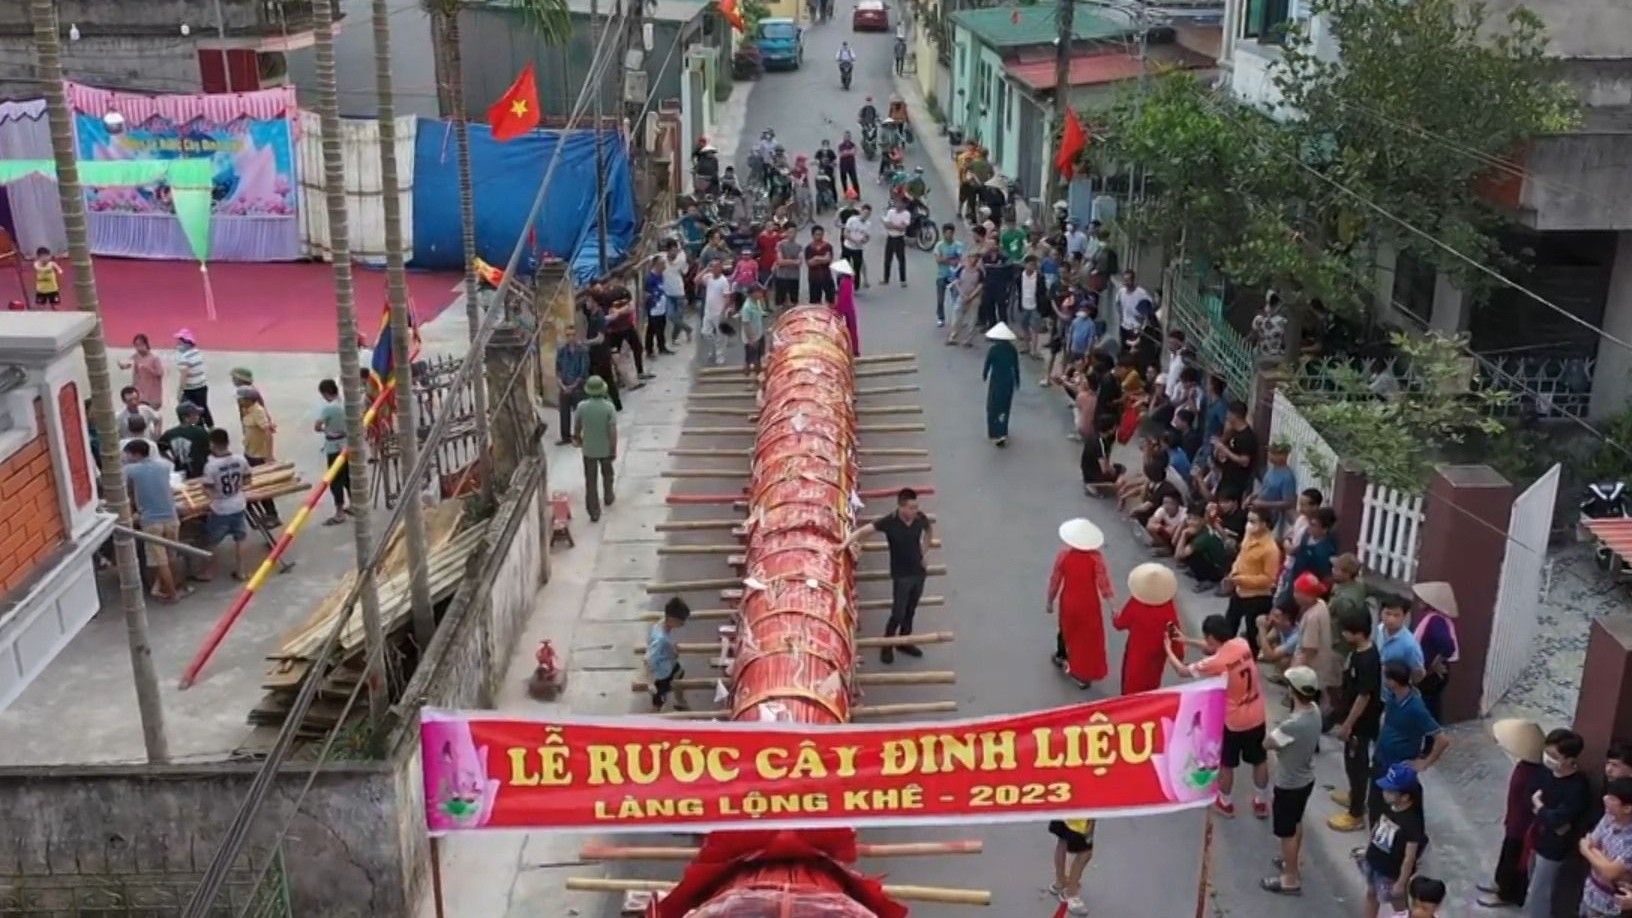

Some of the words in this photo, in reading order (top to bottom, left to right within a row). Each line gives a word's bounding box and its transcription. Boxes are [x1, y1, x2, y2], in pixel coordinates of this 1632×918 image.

[508, 726, 572, 785] LỄ
[586, 738, 740, 784] RƯỚC
[755, 738, 863, 779] CÂY
[880, 730, 1017, 776] ĐINH
[1032, 712, 1156, 775] LIỆU
[594, 794, 704, 819] LÀNG
[719, 790, 829, 819] LỘNG
[844, 783, 924, 810] KHÊ
[969, 782, 1072, 807] 2023
